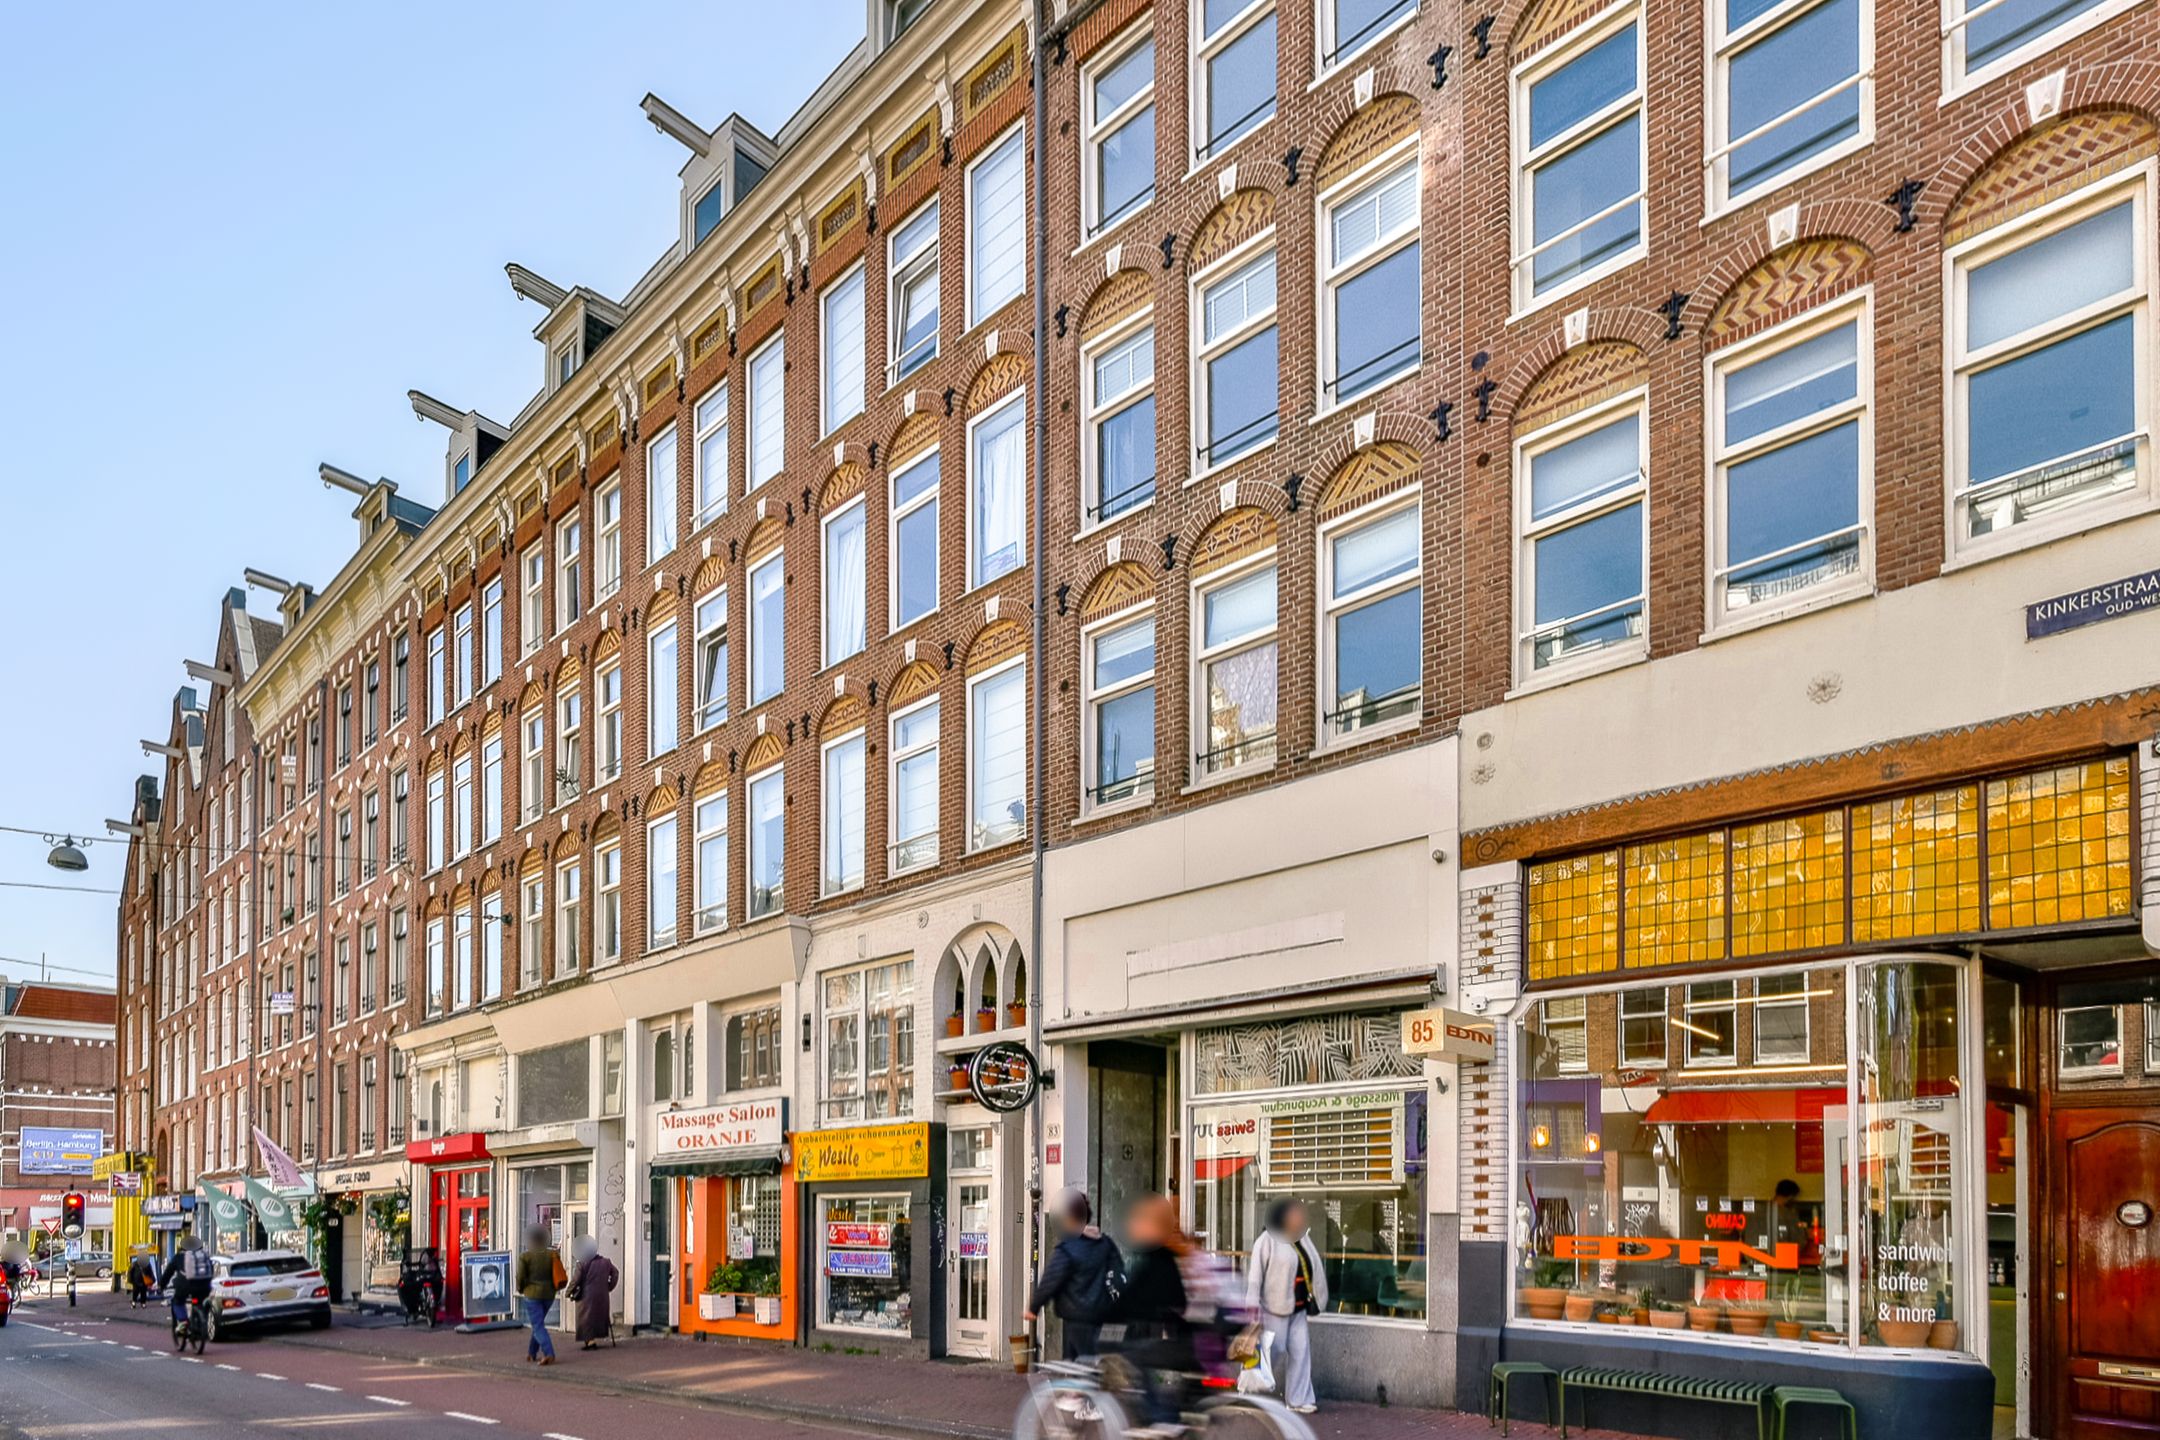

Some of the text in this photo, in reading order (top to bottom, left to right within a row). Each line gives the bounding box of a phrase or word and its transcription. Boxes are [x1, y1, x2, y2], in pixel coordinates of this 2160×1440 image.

[2036, 573, 2160, 620] KINKERSTRAA
[1411, 1019, 1433, 1043] 85
[661, 1103, 776, 1129] Massage Salon
[677, 1129, 757, 1149] ORANJE
[797, 1126, 925, 1144] Ambachtelijke schoenmakerij
[1048, 1126, 1059, 1136] 83
[58, 1140, 96, 1149] Hamburg
[354, 1171, 370, 1183] FOOD
[1878, 1272, 1928, 1292] coffee
[1878, 1302, 1936, 1323] & more
